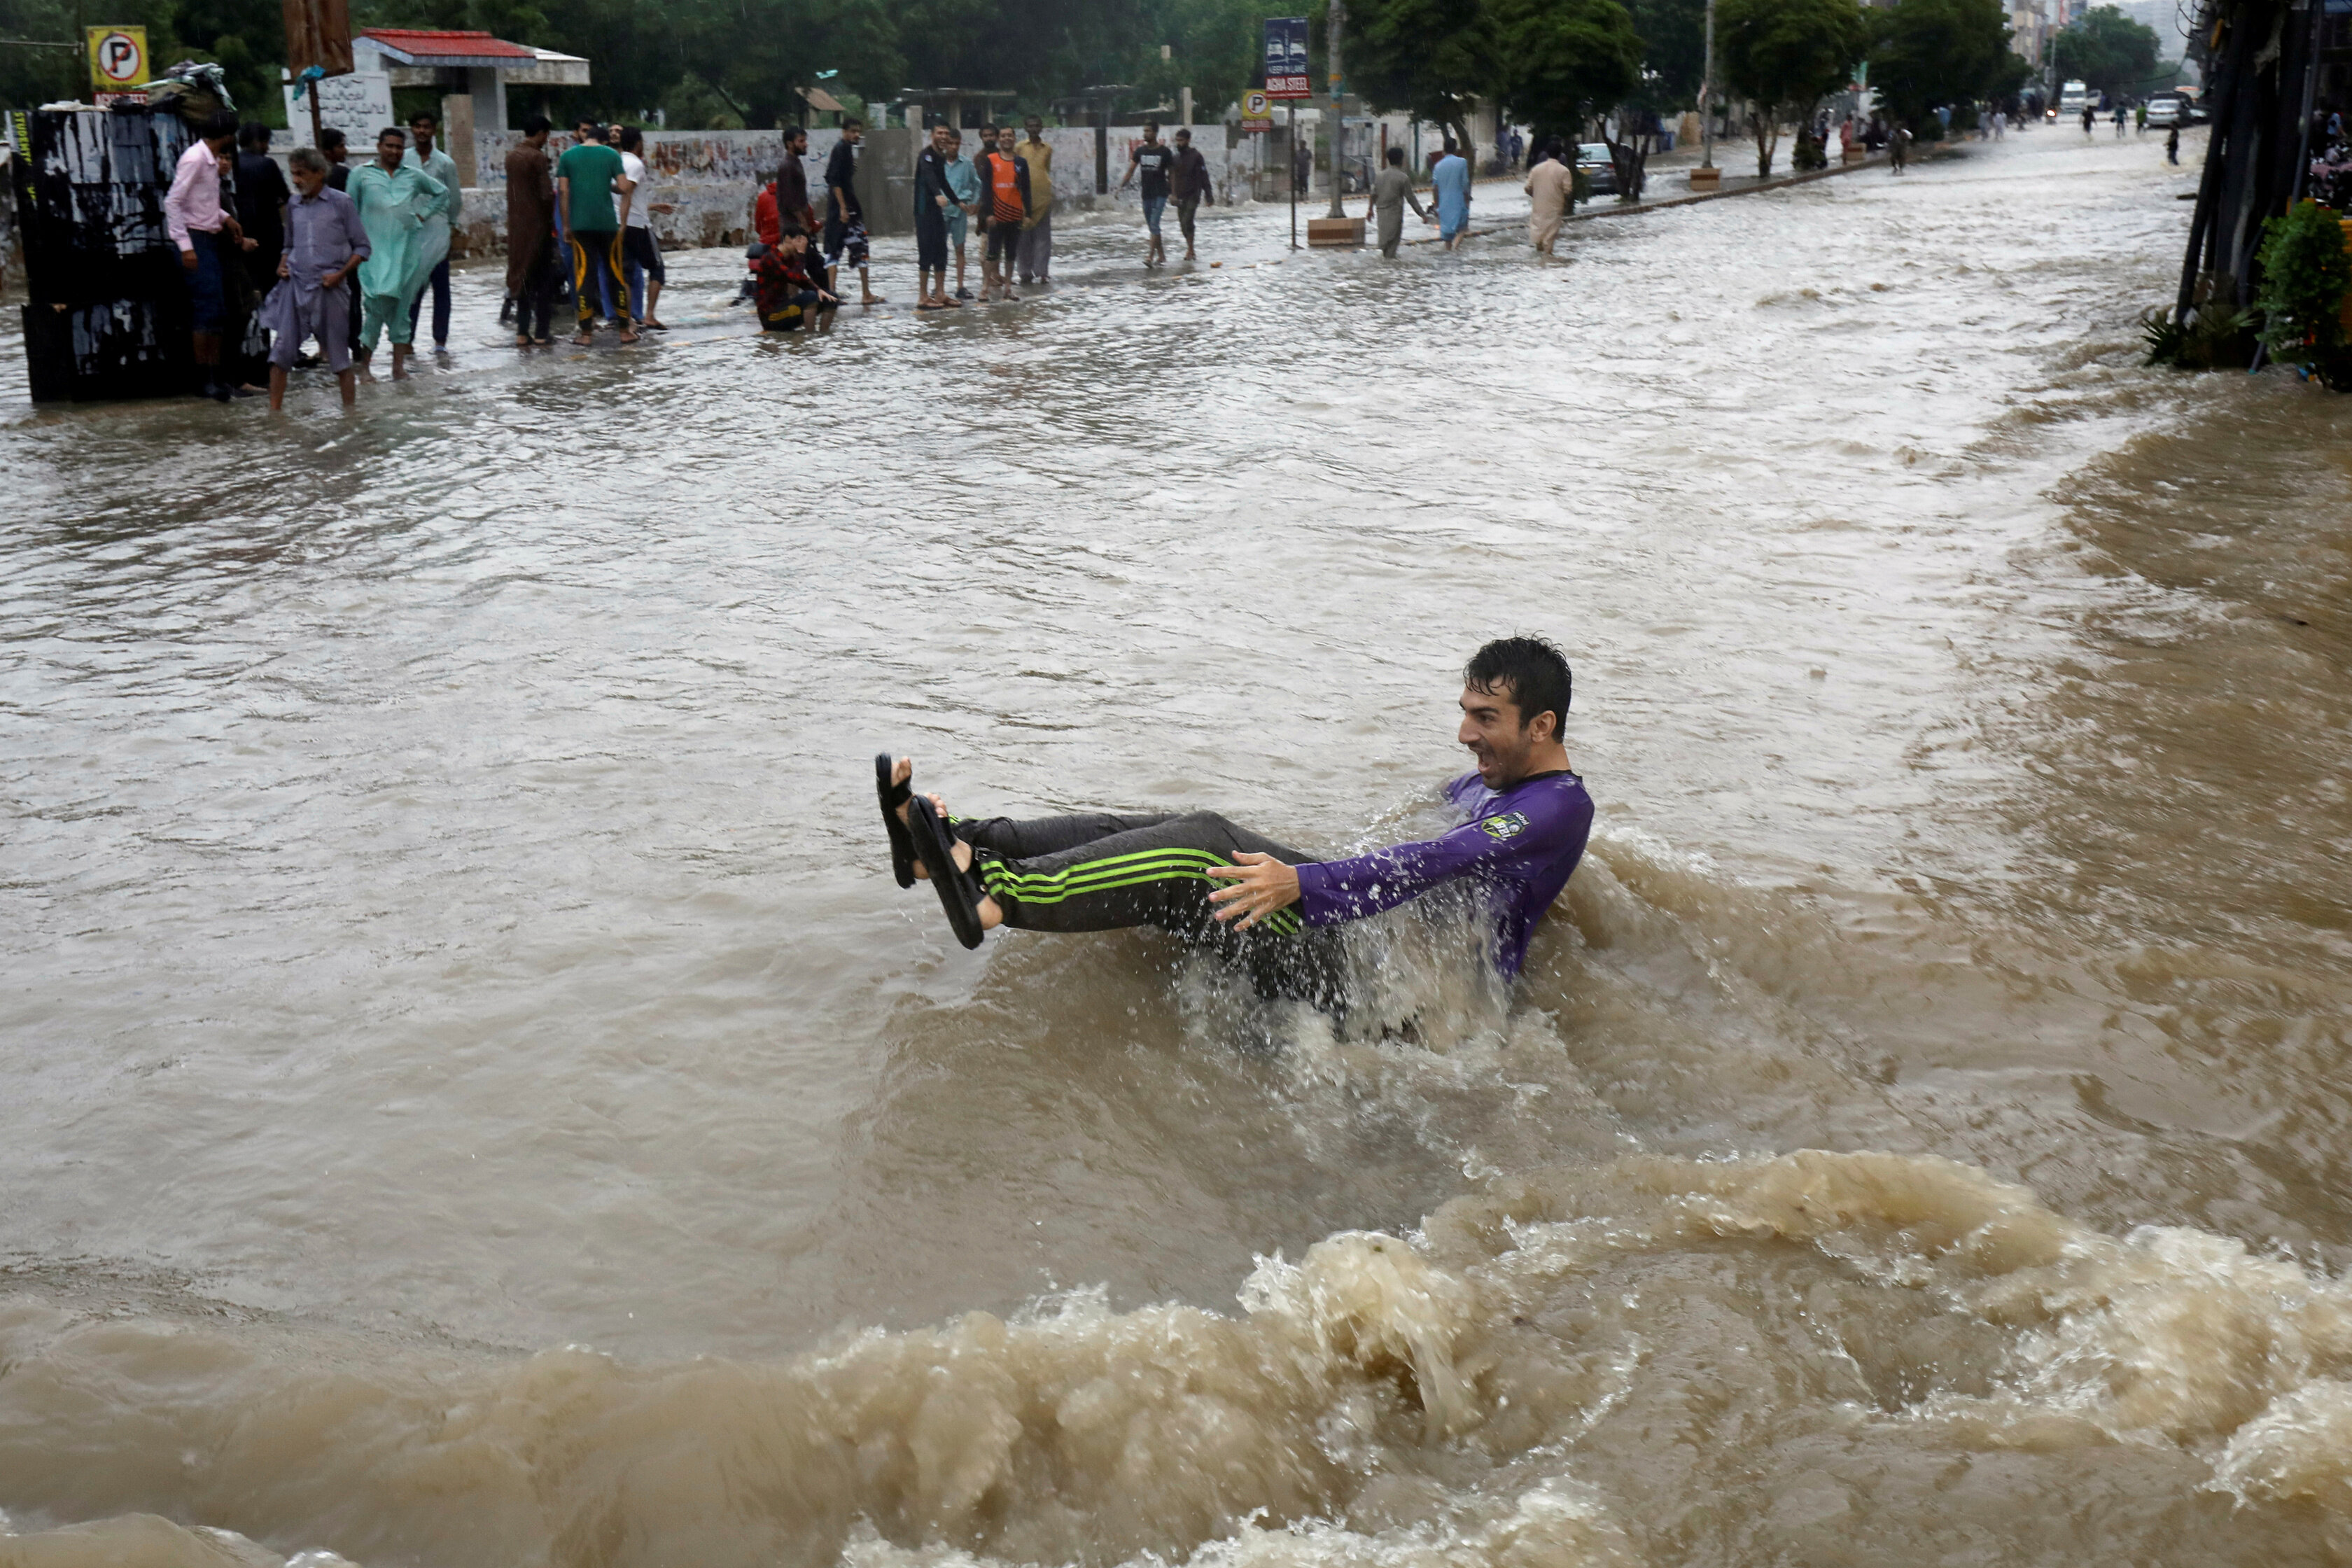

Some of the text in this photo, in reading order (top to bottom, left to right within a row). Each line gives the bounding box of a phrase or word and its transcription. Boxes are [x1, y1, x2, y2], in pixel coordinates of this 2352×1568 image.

[1266, 77, 1309, 90] AGHA STEEL
[1513, 812, 1530, 825] rebel
